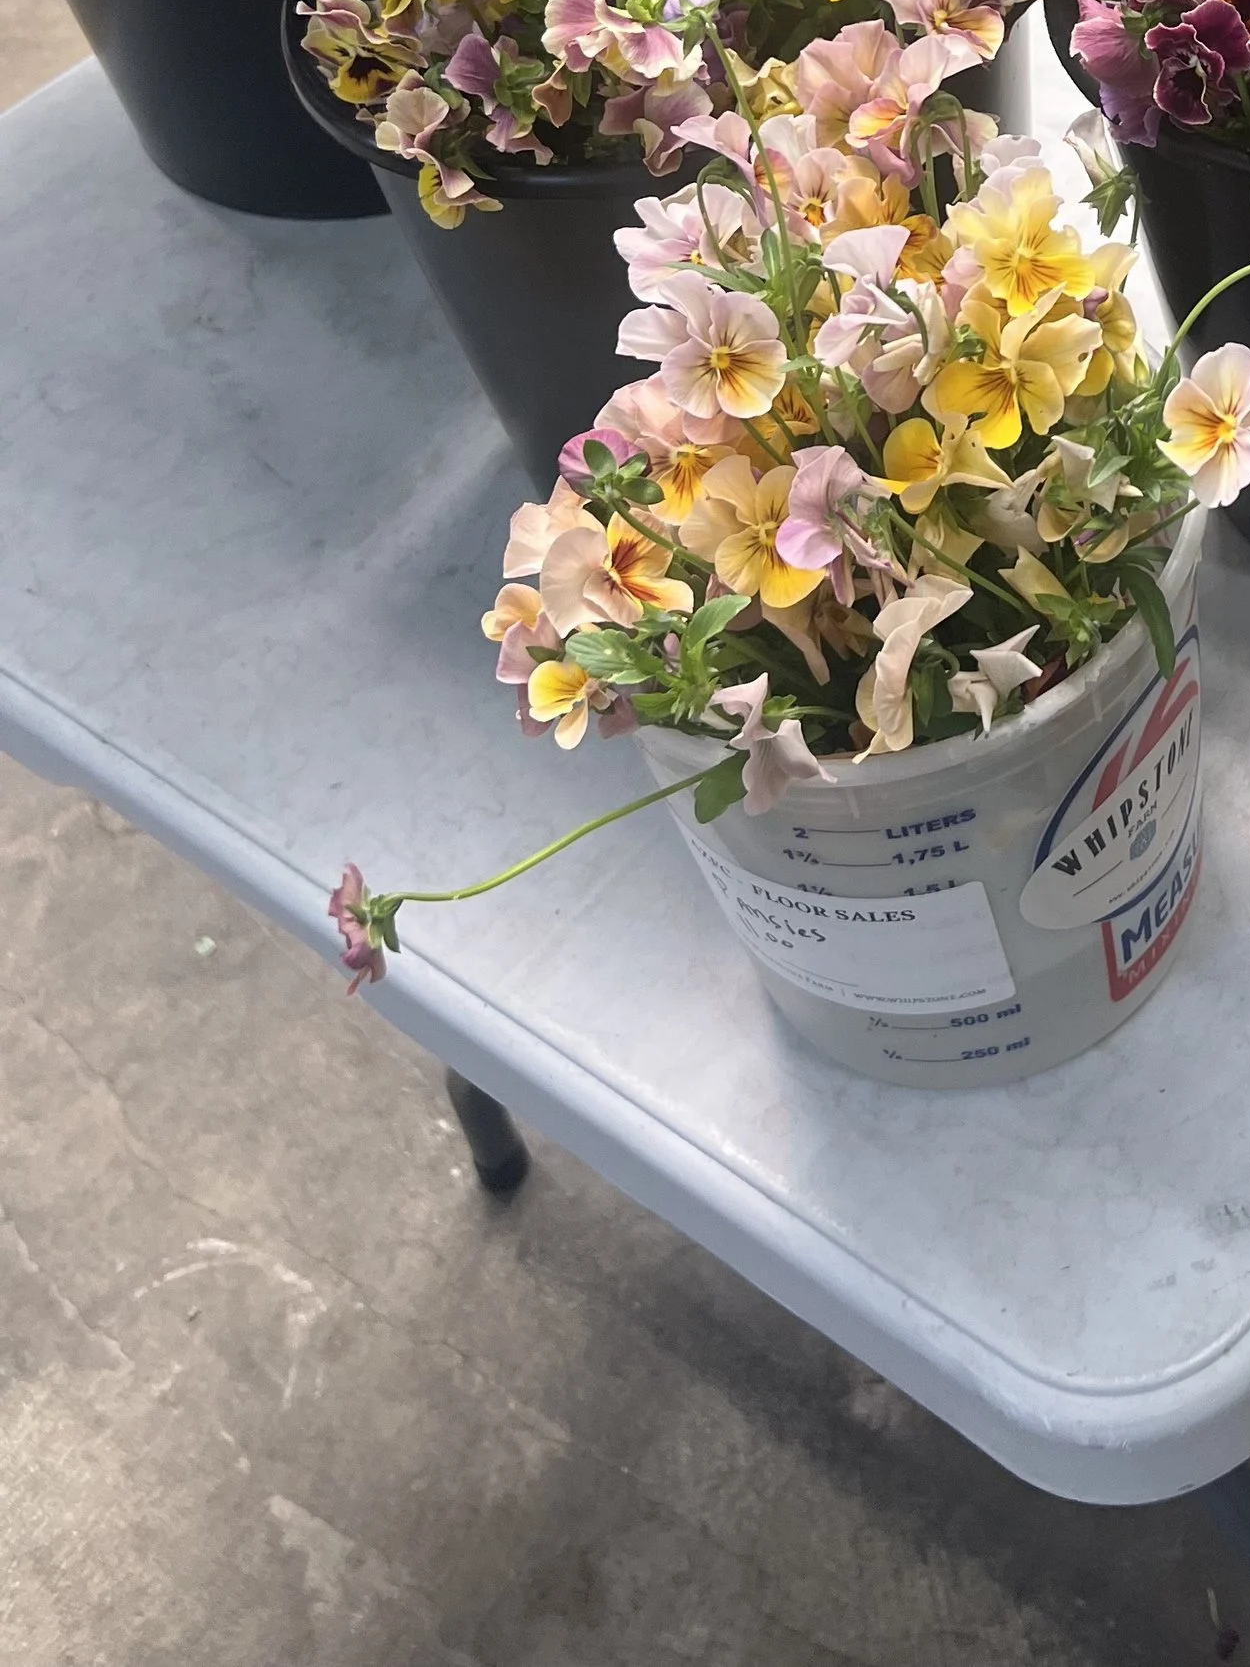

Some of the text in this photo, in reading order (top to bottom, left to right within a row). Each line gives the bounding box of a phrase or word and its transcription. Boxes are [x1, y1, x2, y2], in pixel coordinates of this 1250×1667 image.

[792, 808, 977, 840] 2 LITERS
[891, 845, 946, 865] 1,75
[953, 840, 970, 852] L
[751, 883, 829, 918] FLOOR
[834, 909, 917, 923] SALES
[950, 1013, 990, 1028] 500
[996, 1003, 1022, 1020] ml
[960, 1045, 1000, 1061] 250
[1005, 1036, 1031, 1052] ml
